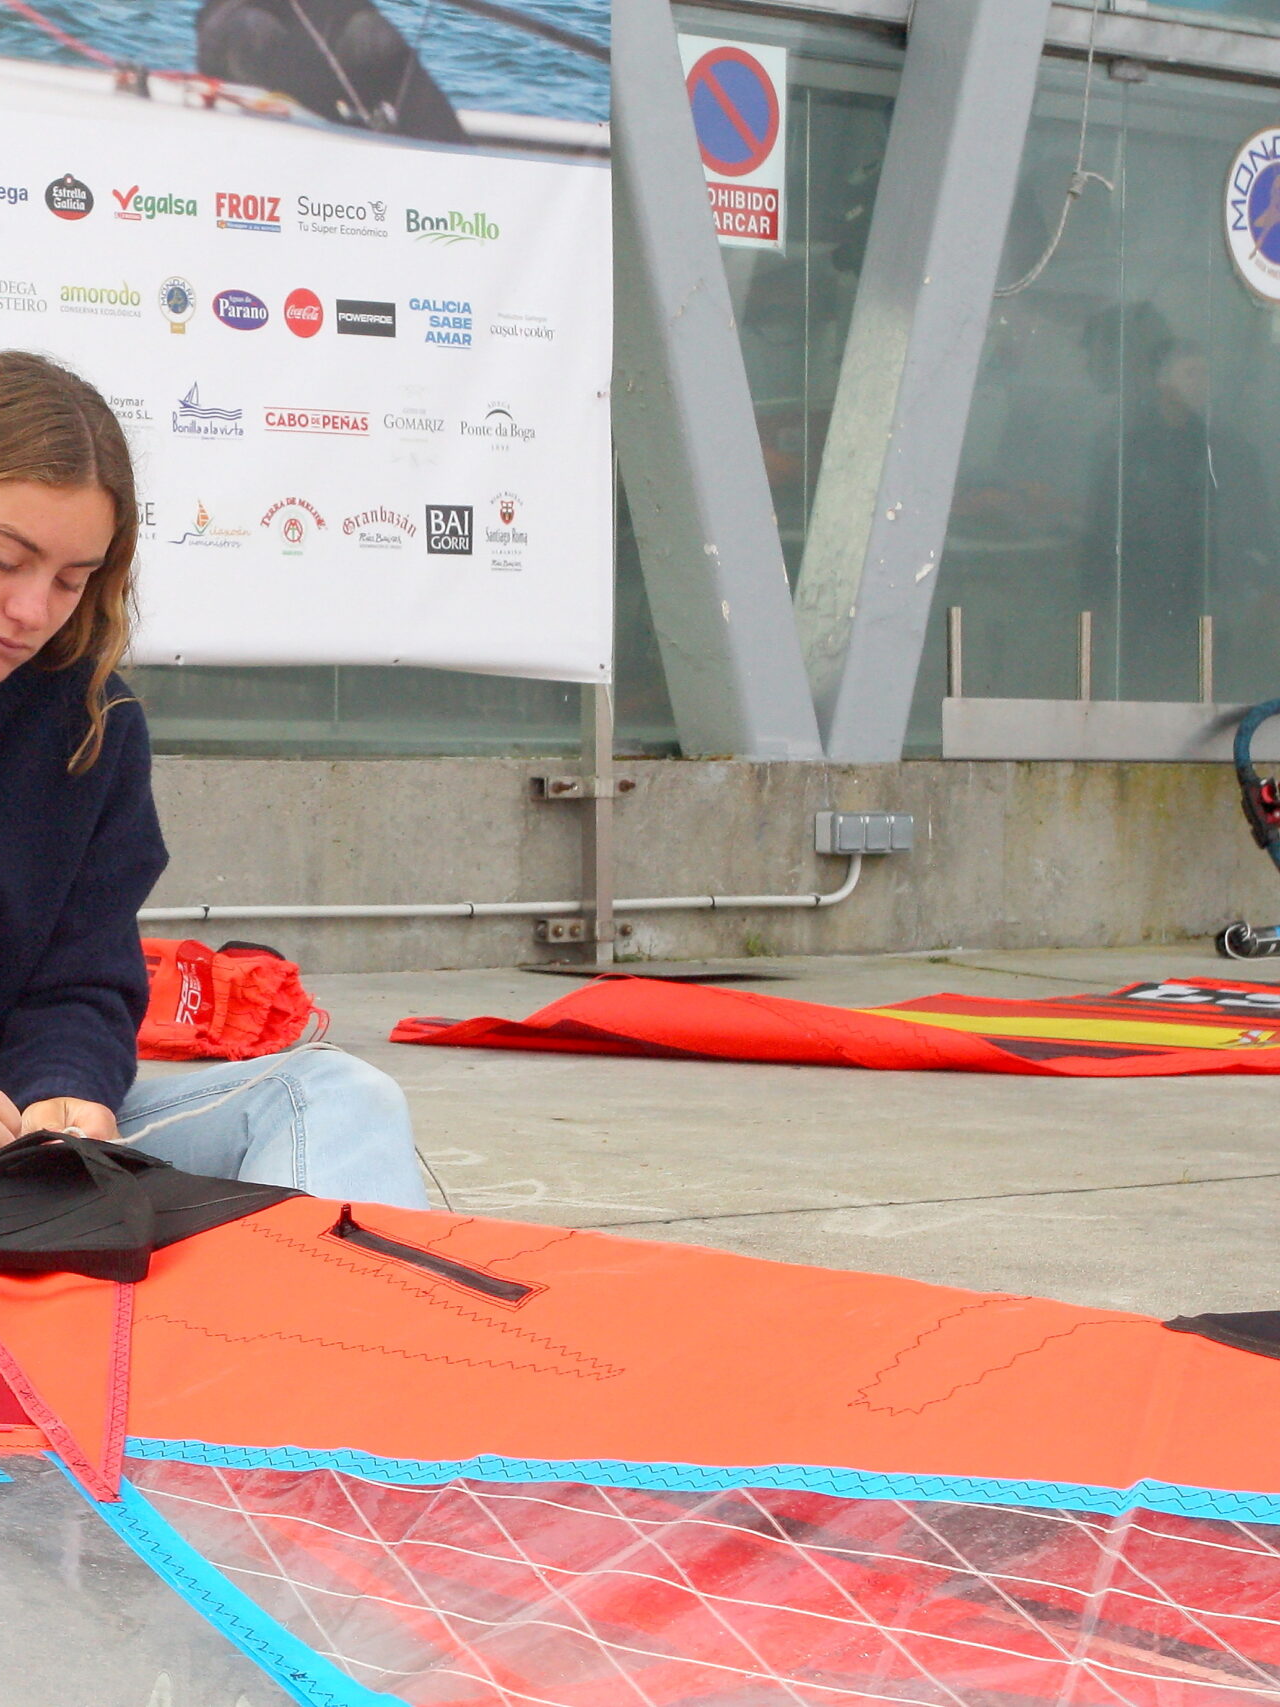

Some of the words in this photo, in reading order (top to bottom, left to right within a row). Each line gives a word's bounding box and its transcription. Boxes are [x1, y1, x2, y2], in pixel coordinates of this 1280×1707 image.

[52, 187, 87, 199] Estrella
[112, 185, 197, 220] Vegalsa
[708, 187, 776, 212] OHIBIDO
[53, 198, 86, 211] Galicia
[215, 192, 281, 222] FROIZ
[297, 196, 367, 221] Supeco
[298, 221, 309, 232] Tu
[311, 222, 337, 235] Super
[340, 224, 388, 238] Económico
[713, 211, 770, 235] ARCAR
[60, 280, 141, 307] amorodo
[409, 298, 472, 314] GALICIA
[338, 313, 393, 325] POWERADE
[429, 315, 472, 330] SABE
[425, 331, 472, 346] AMAR
[108, 395, 144, 408] Joymar
[113, 410, 133, 420] exo
[136, 410, 153, 421] S.L.
[173, 411, 201, 433] Bonilla
[203, 425, 209, 434] a
[210, 421, 218, 435] la
[265, 412, 310, 428] CABO
[311, 416, 320, 425] DE
[322, 412, 369, 431] PEÑAS
[383, 413, 445, 433] GOMARIZ
[460, 420, 492, 437] Ponte
[495, 422, 508, 437] da
[510, 423, 536, 441] Boga
[430, 510, 469, 535] BAI
[431, 536, 469, 550] GORRI
